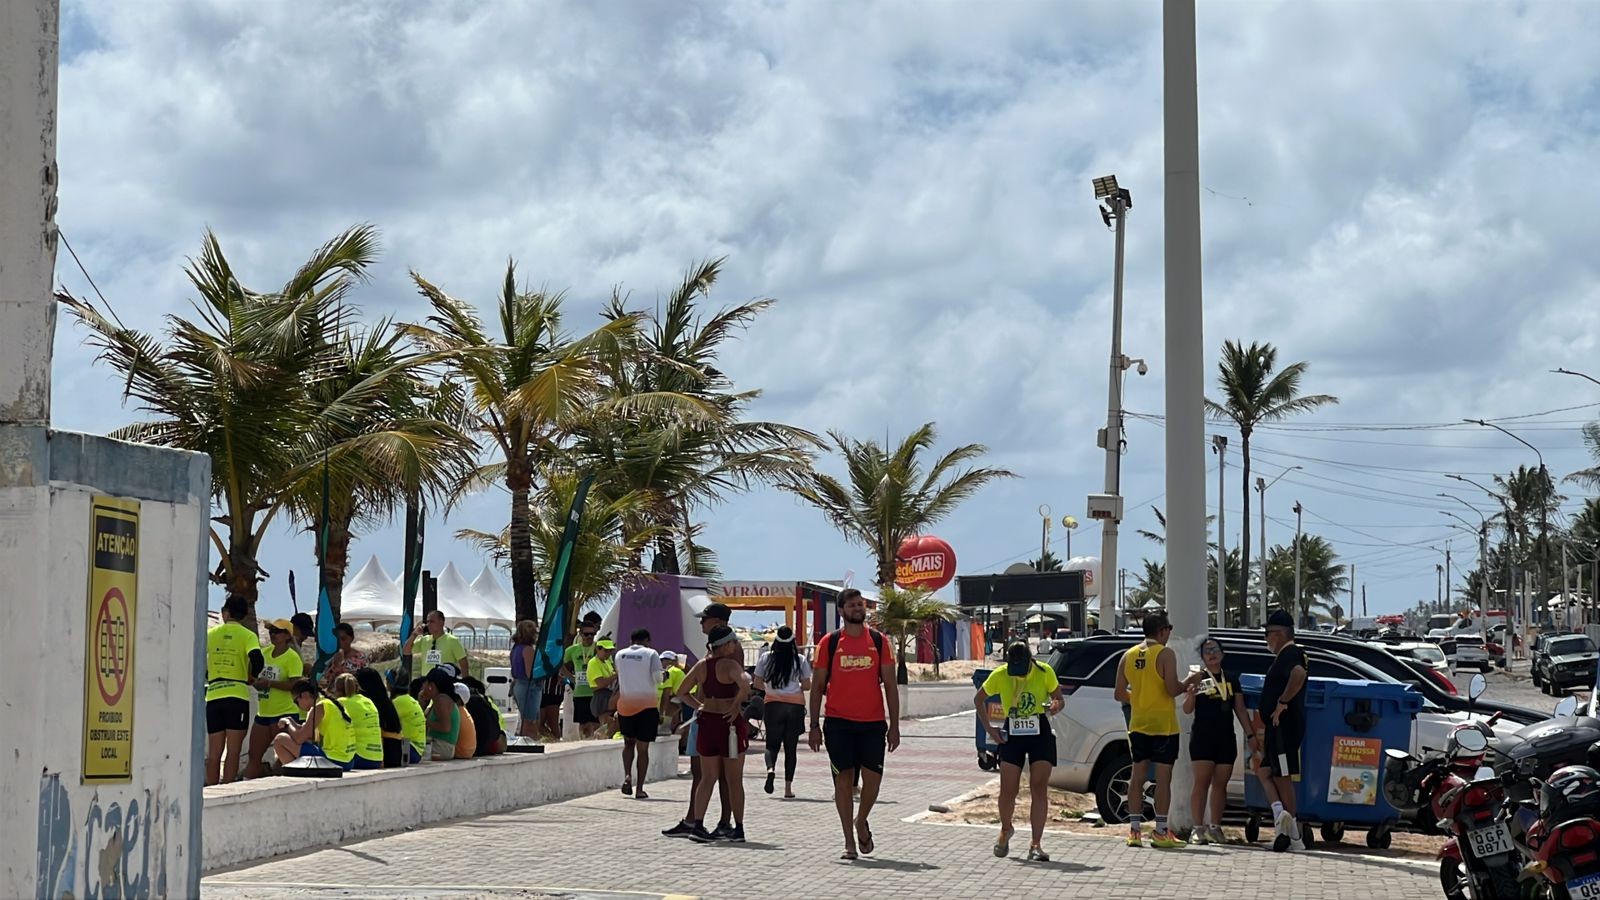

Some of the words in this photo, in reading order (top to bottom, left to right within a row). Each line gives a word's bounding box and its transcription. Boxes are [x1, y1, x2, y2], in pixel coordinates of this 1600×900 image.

[96, 532, 135, 560] ATENÇÃO
[895, 562, 912, 577] ede
[911, 555, 943, 573] MAIS
[98, 711, 123, 724] PROIBIDO
[1013, 720, 1036, 729] 8115
[89, 729, 116, 741] OBSTRUIR
[116, 729, 130, 742] ESTE
[1338, 738, 1367, 747] CUIDAR
[100, 747, 119, 759] LOCAL
[1475, 829, 1504, 845] QGP
[1477, 839, 1508, 855] 8871
